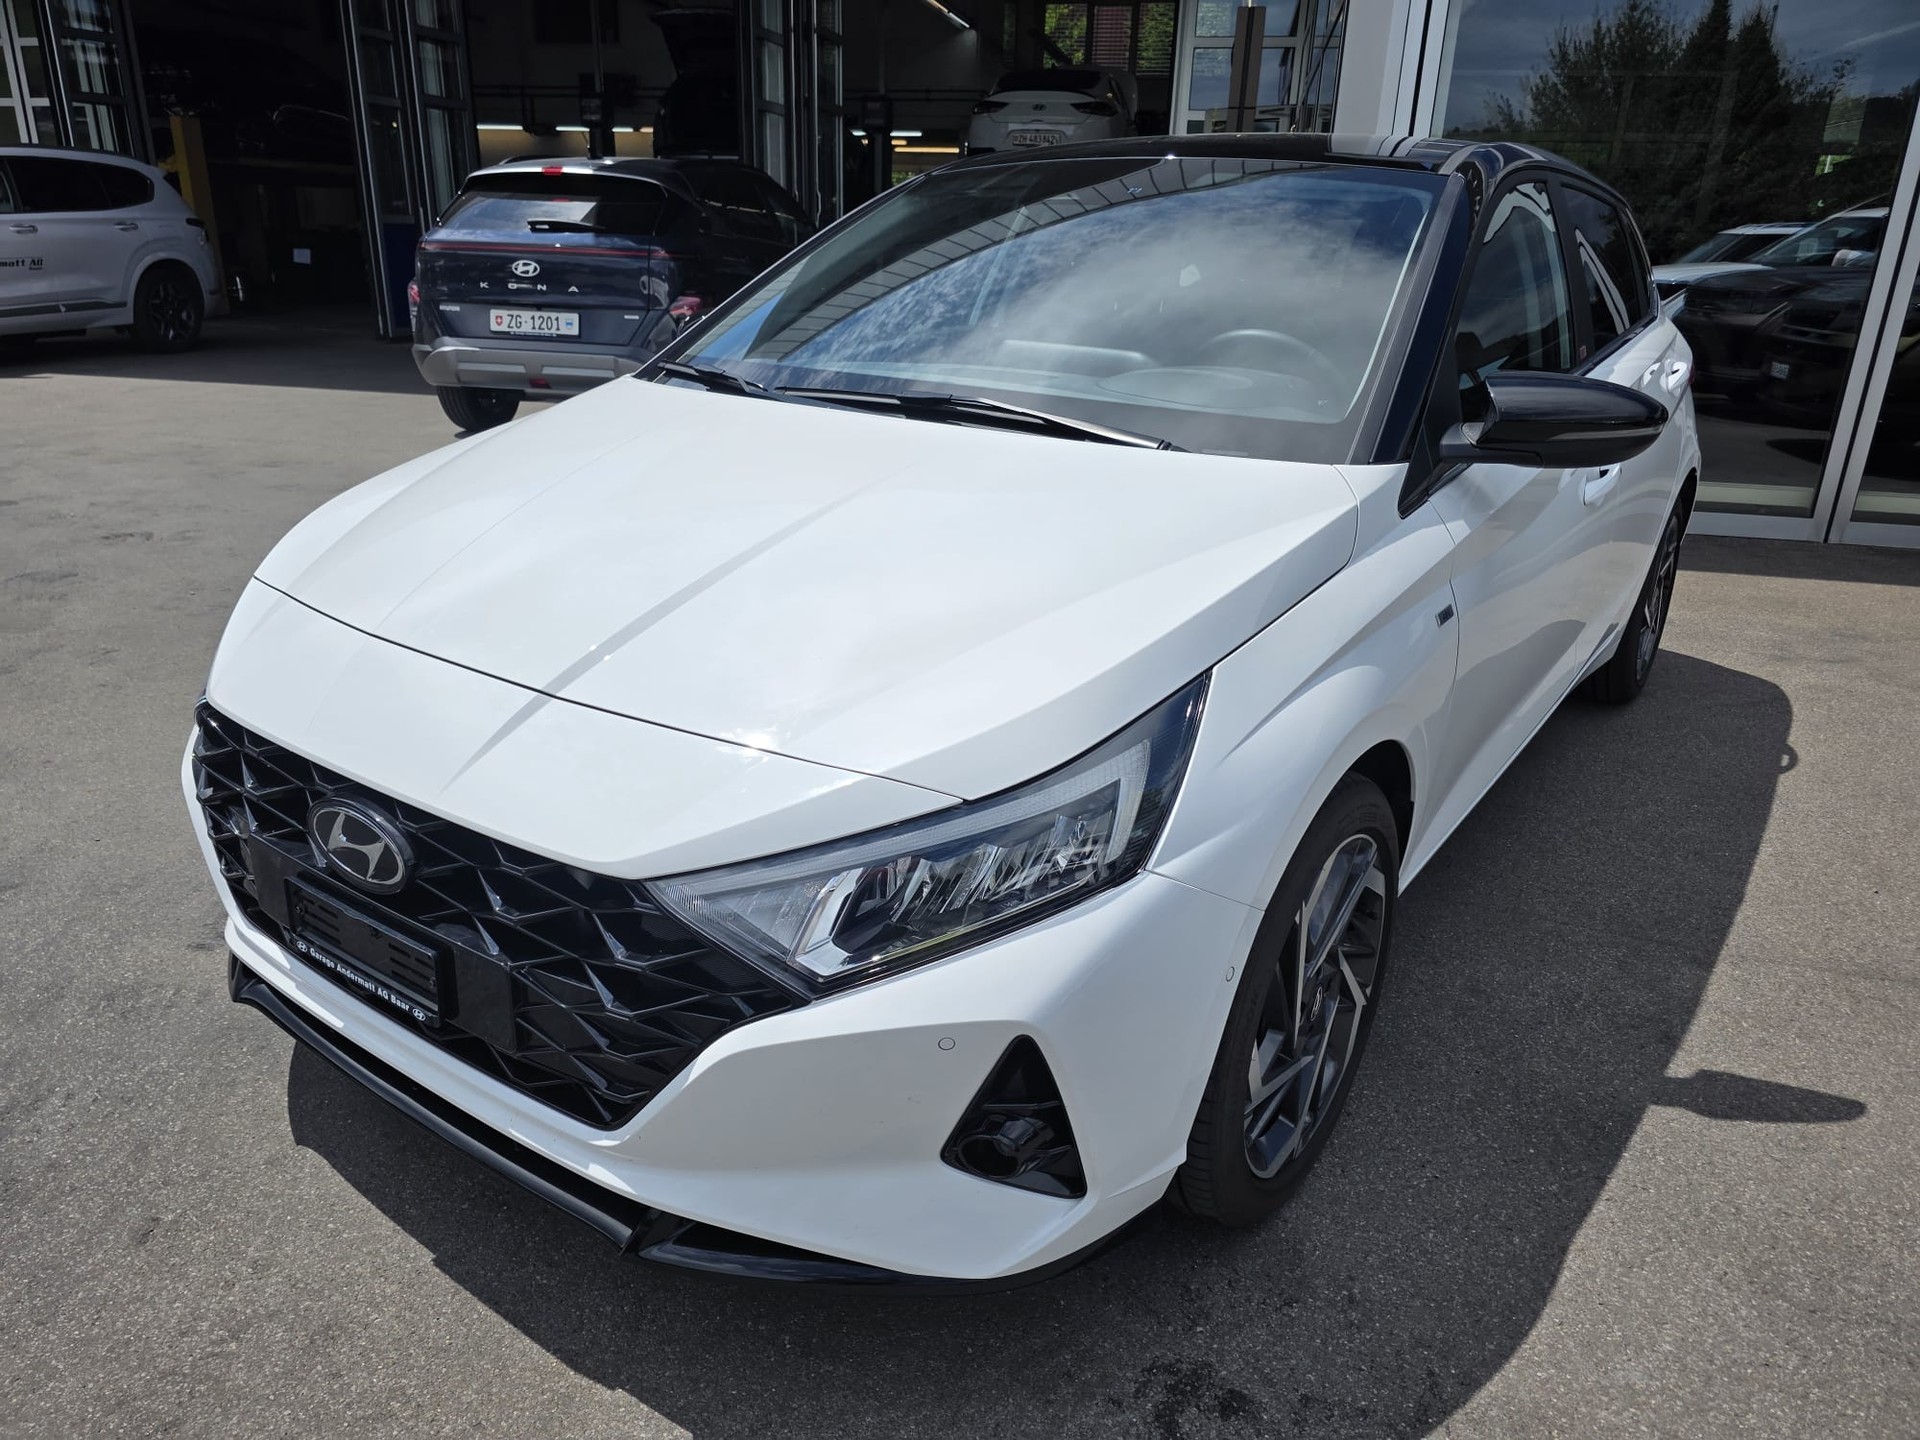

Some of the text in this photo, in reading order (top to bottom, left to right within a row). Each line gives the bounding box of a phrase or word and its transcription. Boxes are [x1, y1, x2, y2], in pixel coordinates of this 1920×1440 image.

[309, 947, 335, 969] Garage
[336, 963, 376, 992] Andermatt
[391, 994, 410, 1012] Baar
